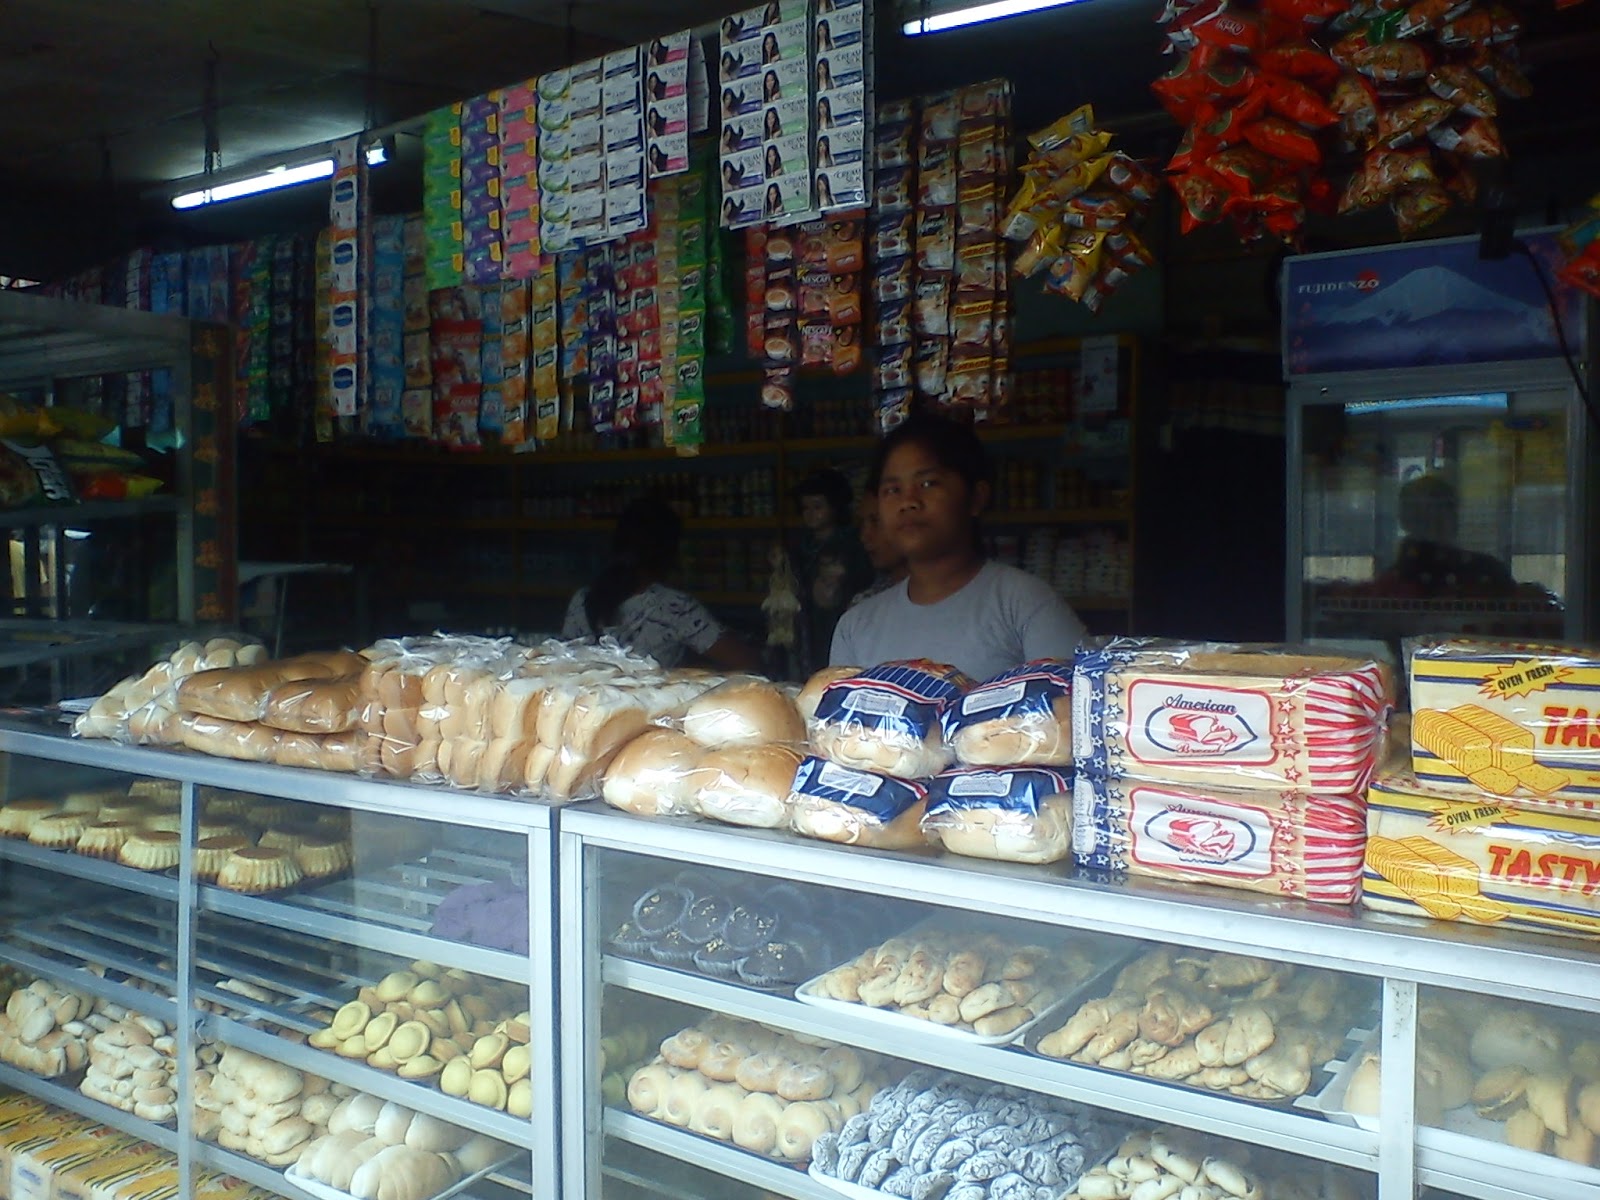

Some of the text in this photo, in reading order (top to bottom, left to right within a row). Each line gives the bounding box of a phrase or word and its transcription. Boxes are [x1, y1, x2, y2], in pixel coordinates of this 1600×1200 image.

[1298, 278, 1380, 294] FUJIDENZO
[1497, 663, 1555, 693] OVEN FRESH
[1164, 693, 1237, 714] American
[1446, 804, 1502, 827] OVEN FRESH
[1488, 844, 1600, 897] TASTY
